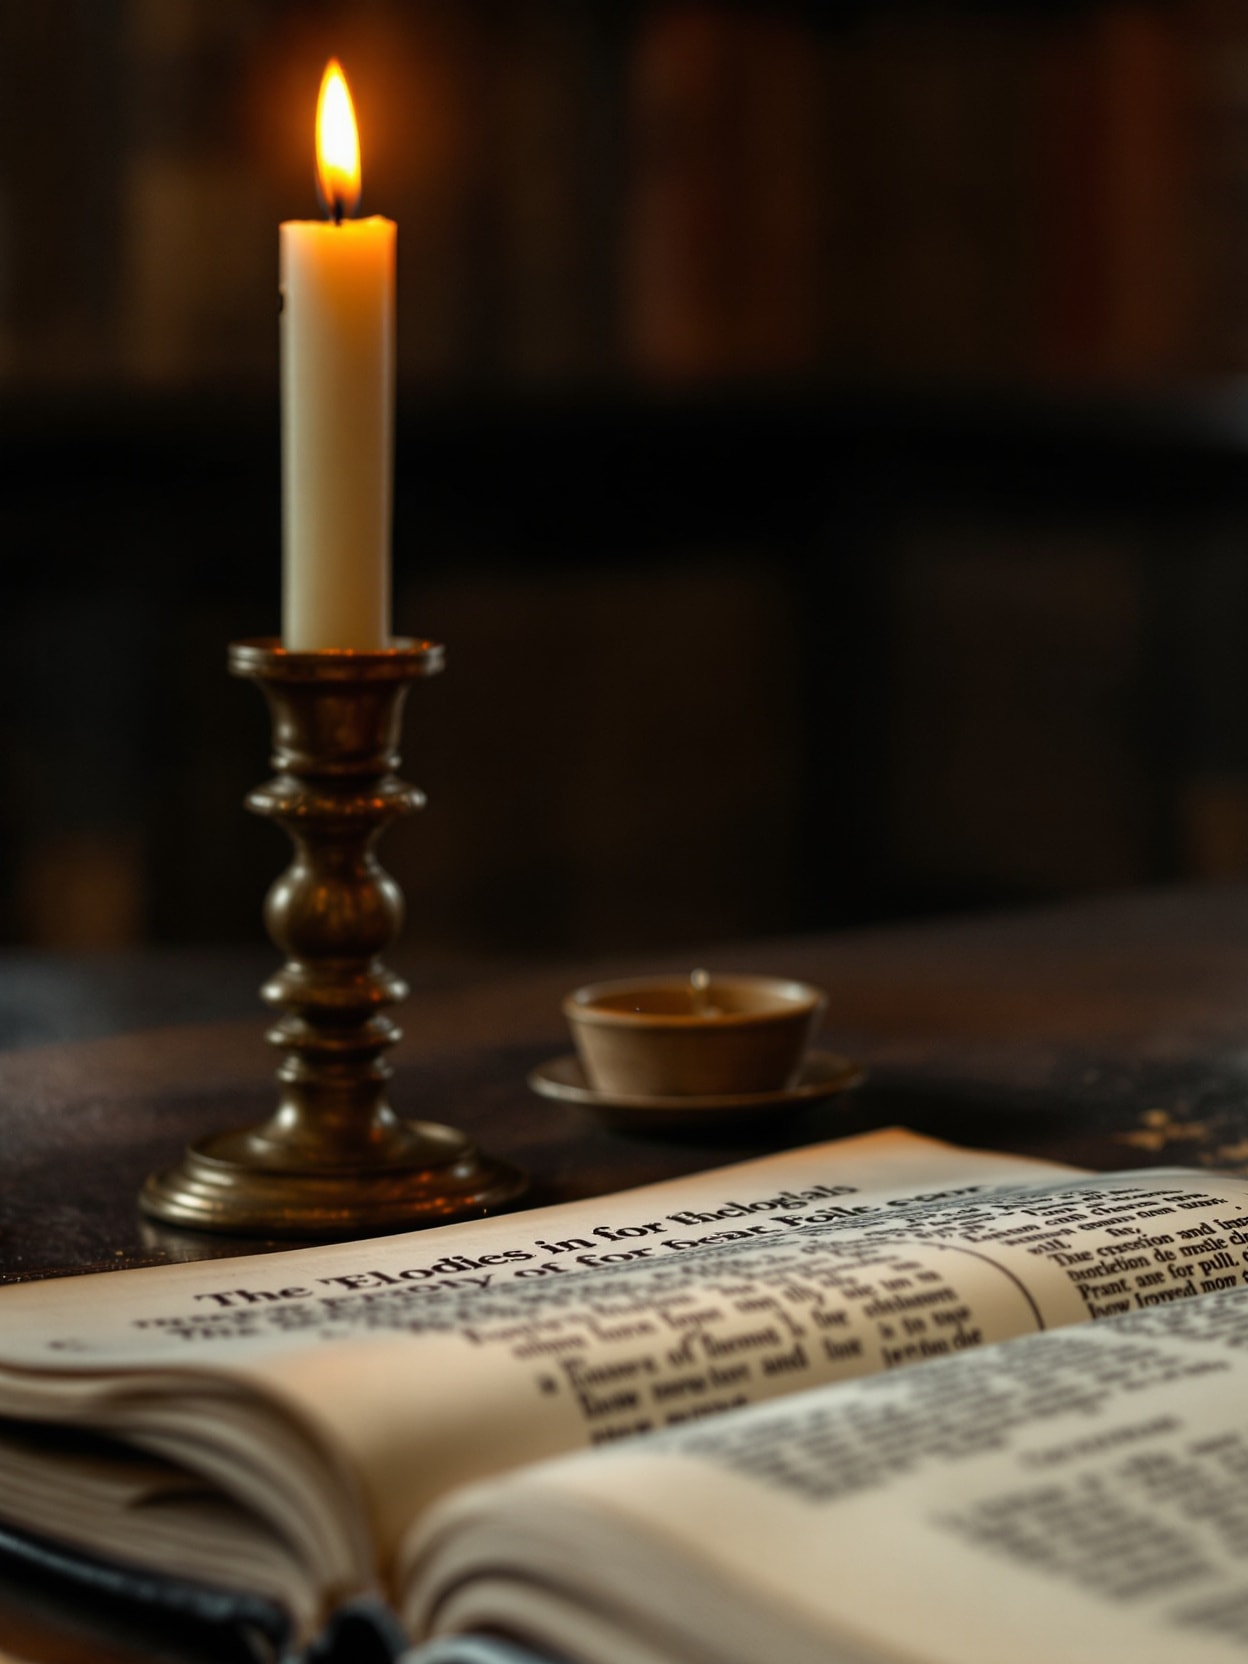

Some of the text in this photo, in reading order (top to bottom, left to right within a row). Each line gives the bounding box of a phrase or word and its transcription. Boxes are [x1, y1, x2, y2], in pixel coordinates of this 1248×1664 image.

[1180, 1222, 1217, 1241] and
[193, 1285, 313, 1308] The
[535, 1239, 596, 1255] in
[593, 1221, 667, 1242] for
[514, 1261, 570, 1278] of
[576, 1246, 657, 1268] for
[1167, 1263, 1195, 1280] for
